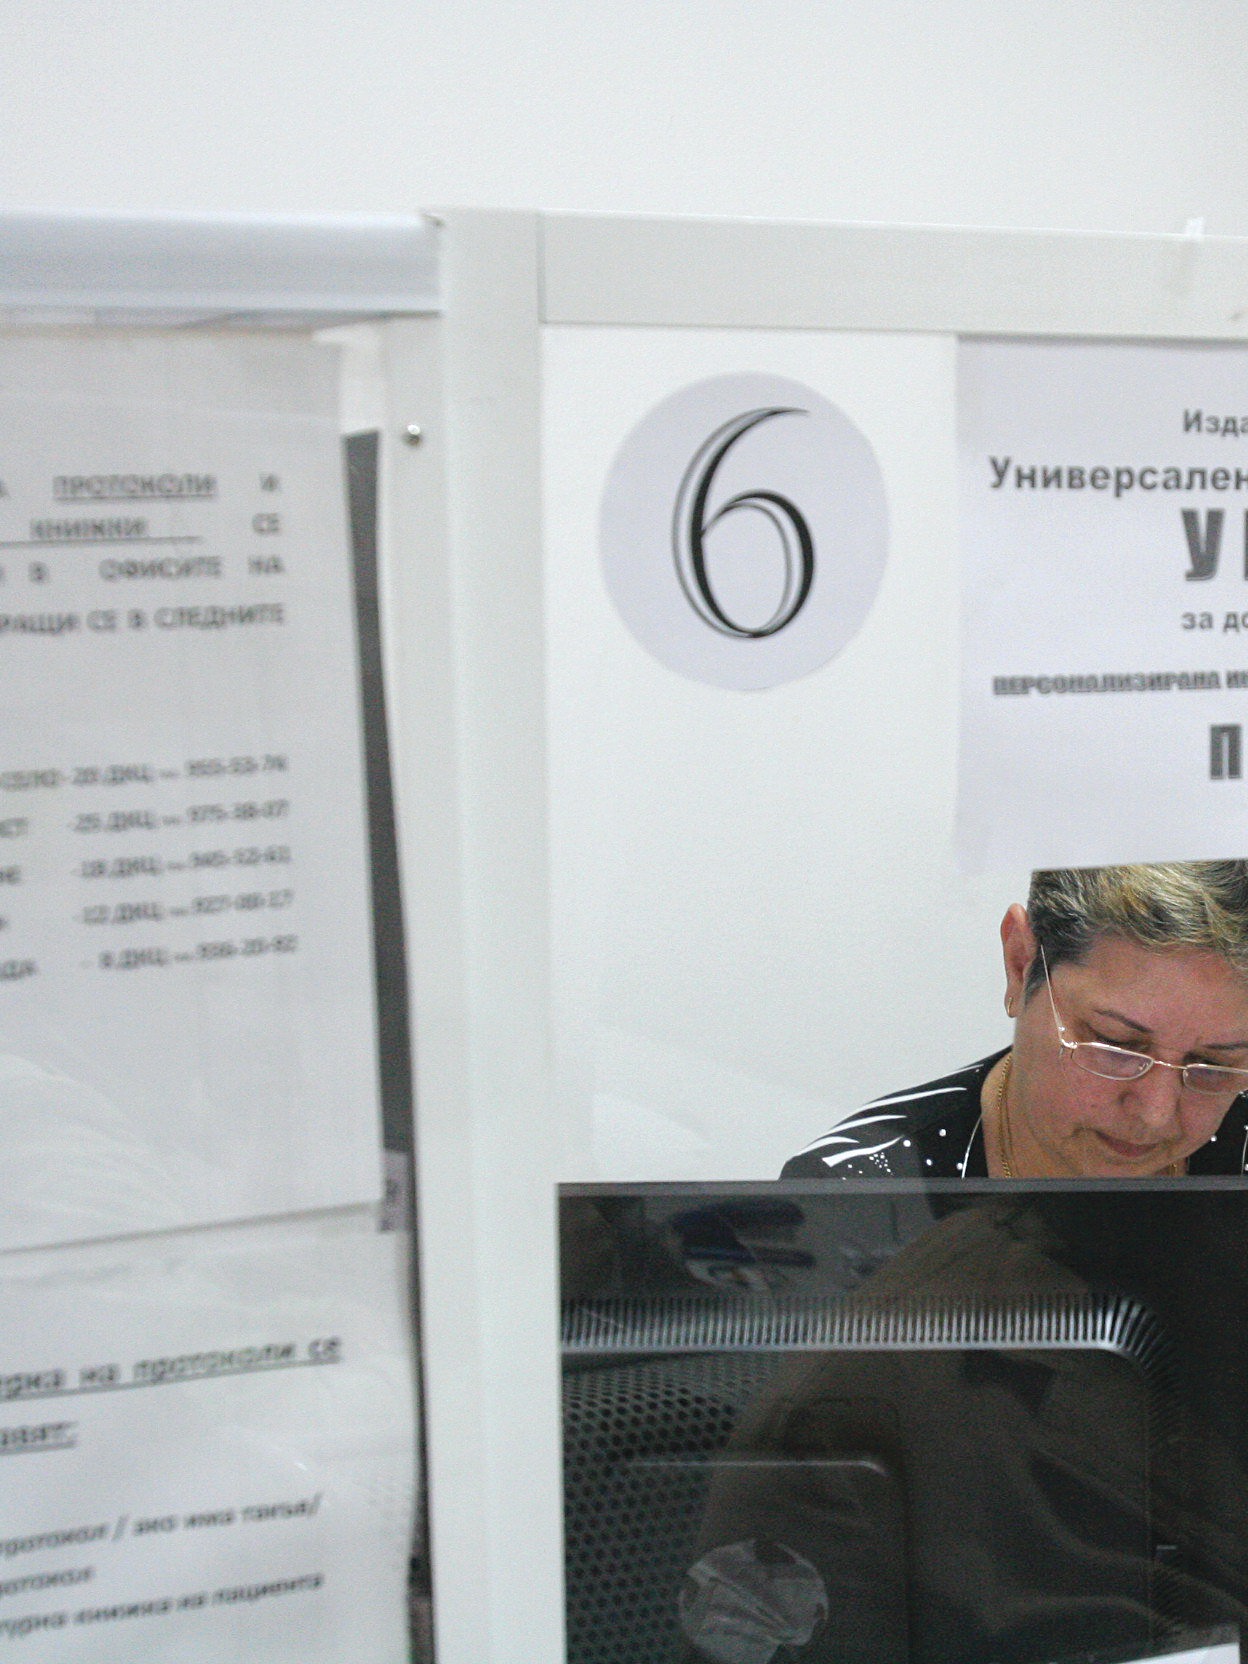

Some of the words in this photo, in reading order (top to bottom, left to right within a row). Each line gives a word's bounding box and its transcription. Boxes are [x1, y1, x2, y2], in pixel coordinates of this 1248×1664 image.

[252, 512, 280, 535] СЕ
[671, 406, 815, 640] 6
[1181, 611, 1213, 631] за
[992, 671, 1221, 697] ПЕРСОНАЛИЗИРАНА
[133, 1342, 297, 1384] протоколи
